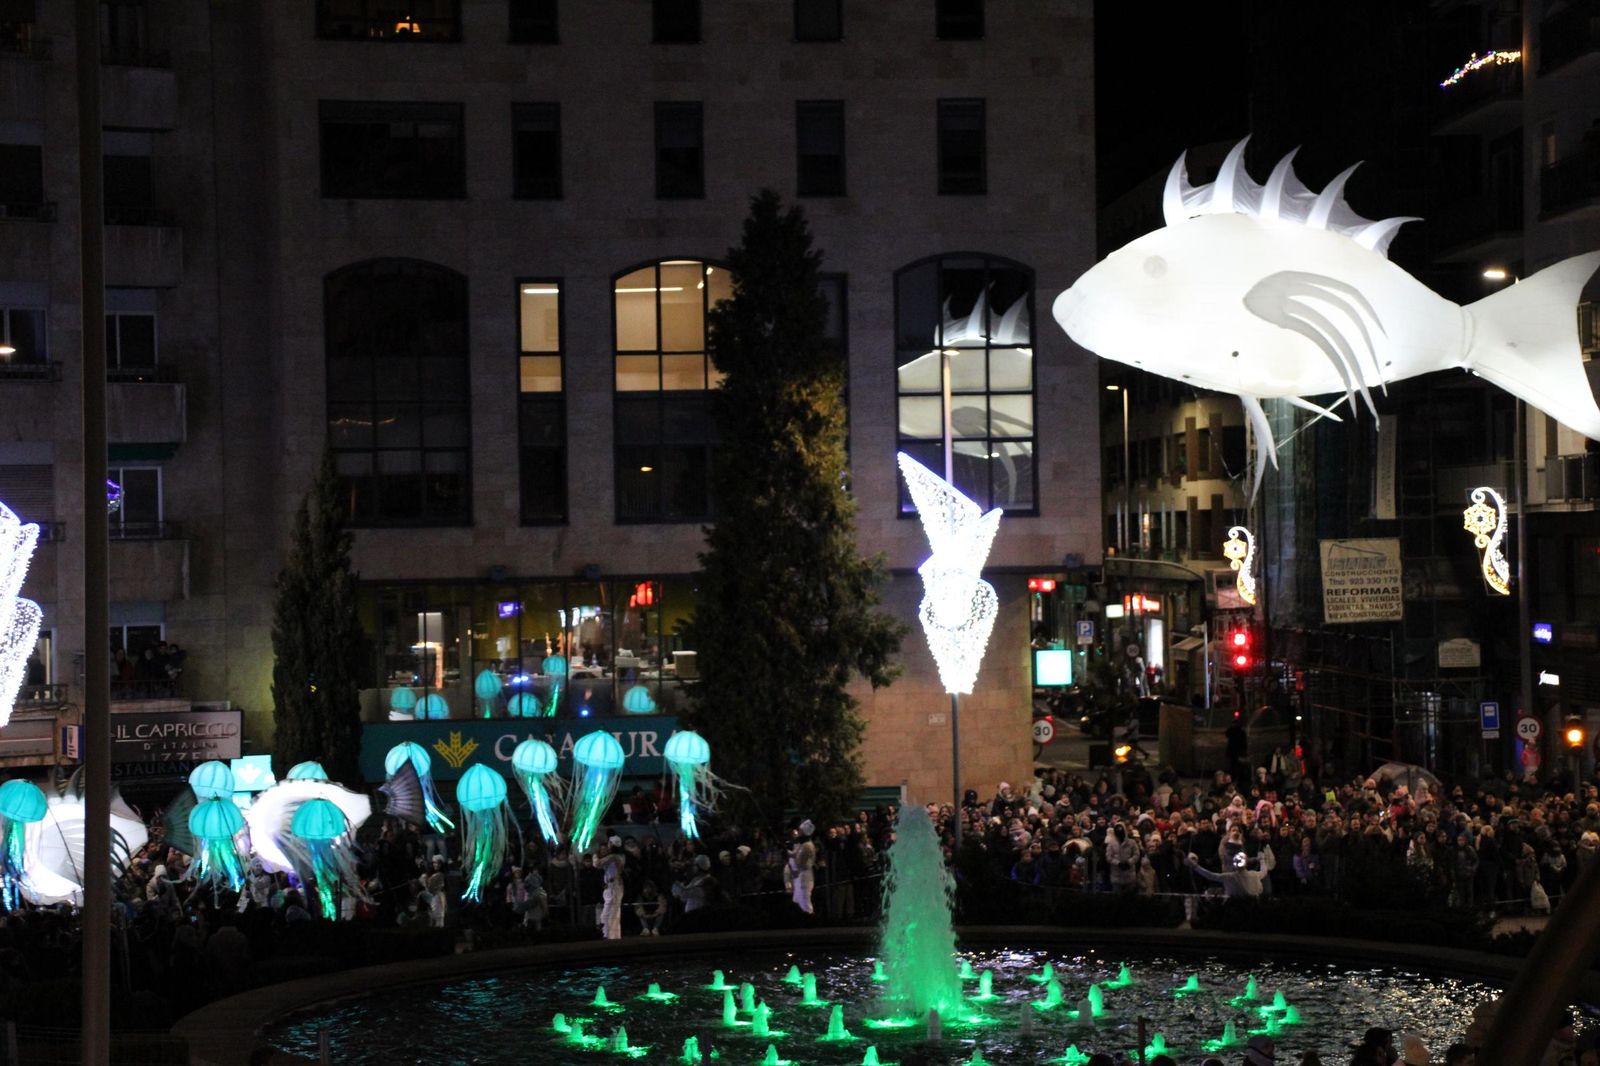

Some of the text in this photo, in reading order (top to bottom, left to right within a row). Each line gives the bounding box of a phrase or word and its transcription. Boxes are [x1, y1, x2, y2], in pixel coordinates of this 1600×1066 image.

[1326, 587, 1400, 596] REFORMAS
[1360, 595, 1401, 603] VIVIENDAS
[1080, 622, 1090, 635] P
[135, 722, 238, 738] CAPRICCIO
[1034, 726, 1050, 736] 30
[1520, 723, 1538, 734] 30
